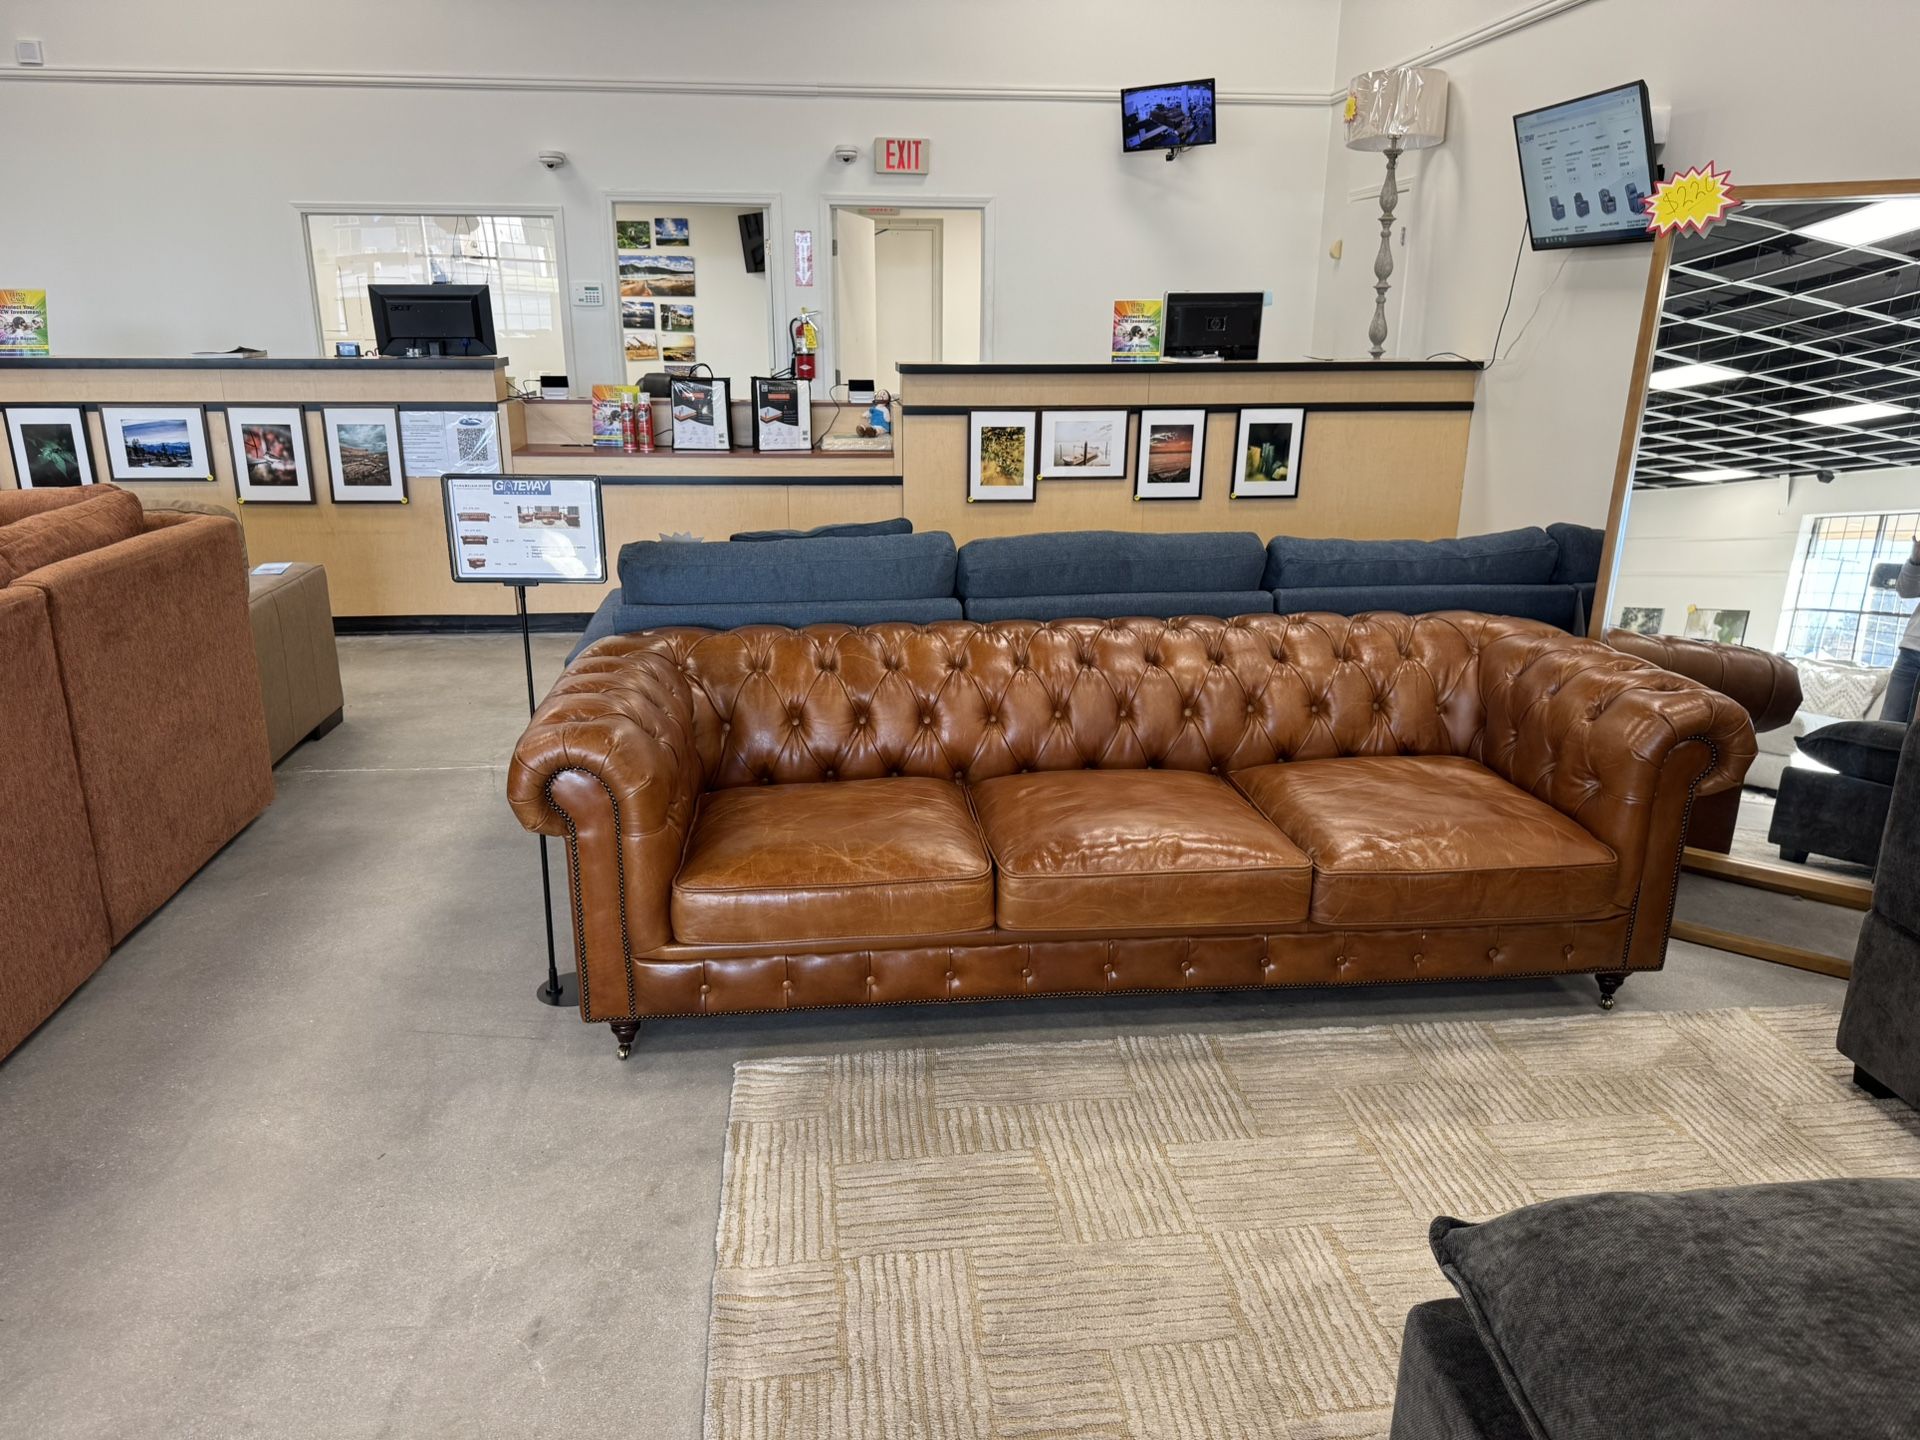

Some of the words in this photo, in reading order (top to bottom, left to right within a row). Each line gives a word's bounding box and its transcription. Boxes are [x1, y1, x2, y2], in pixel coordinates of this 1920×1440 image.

[885, 139, 922, 170] EXIT
[1662, 176, 1716, 215] $220
[390, 304, 414, 312] acer
[494, 480, 550, 491] GATEWAY
